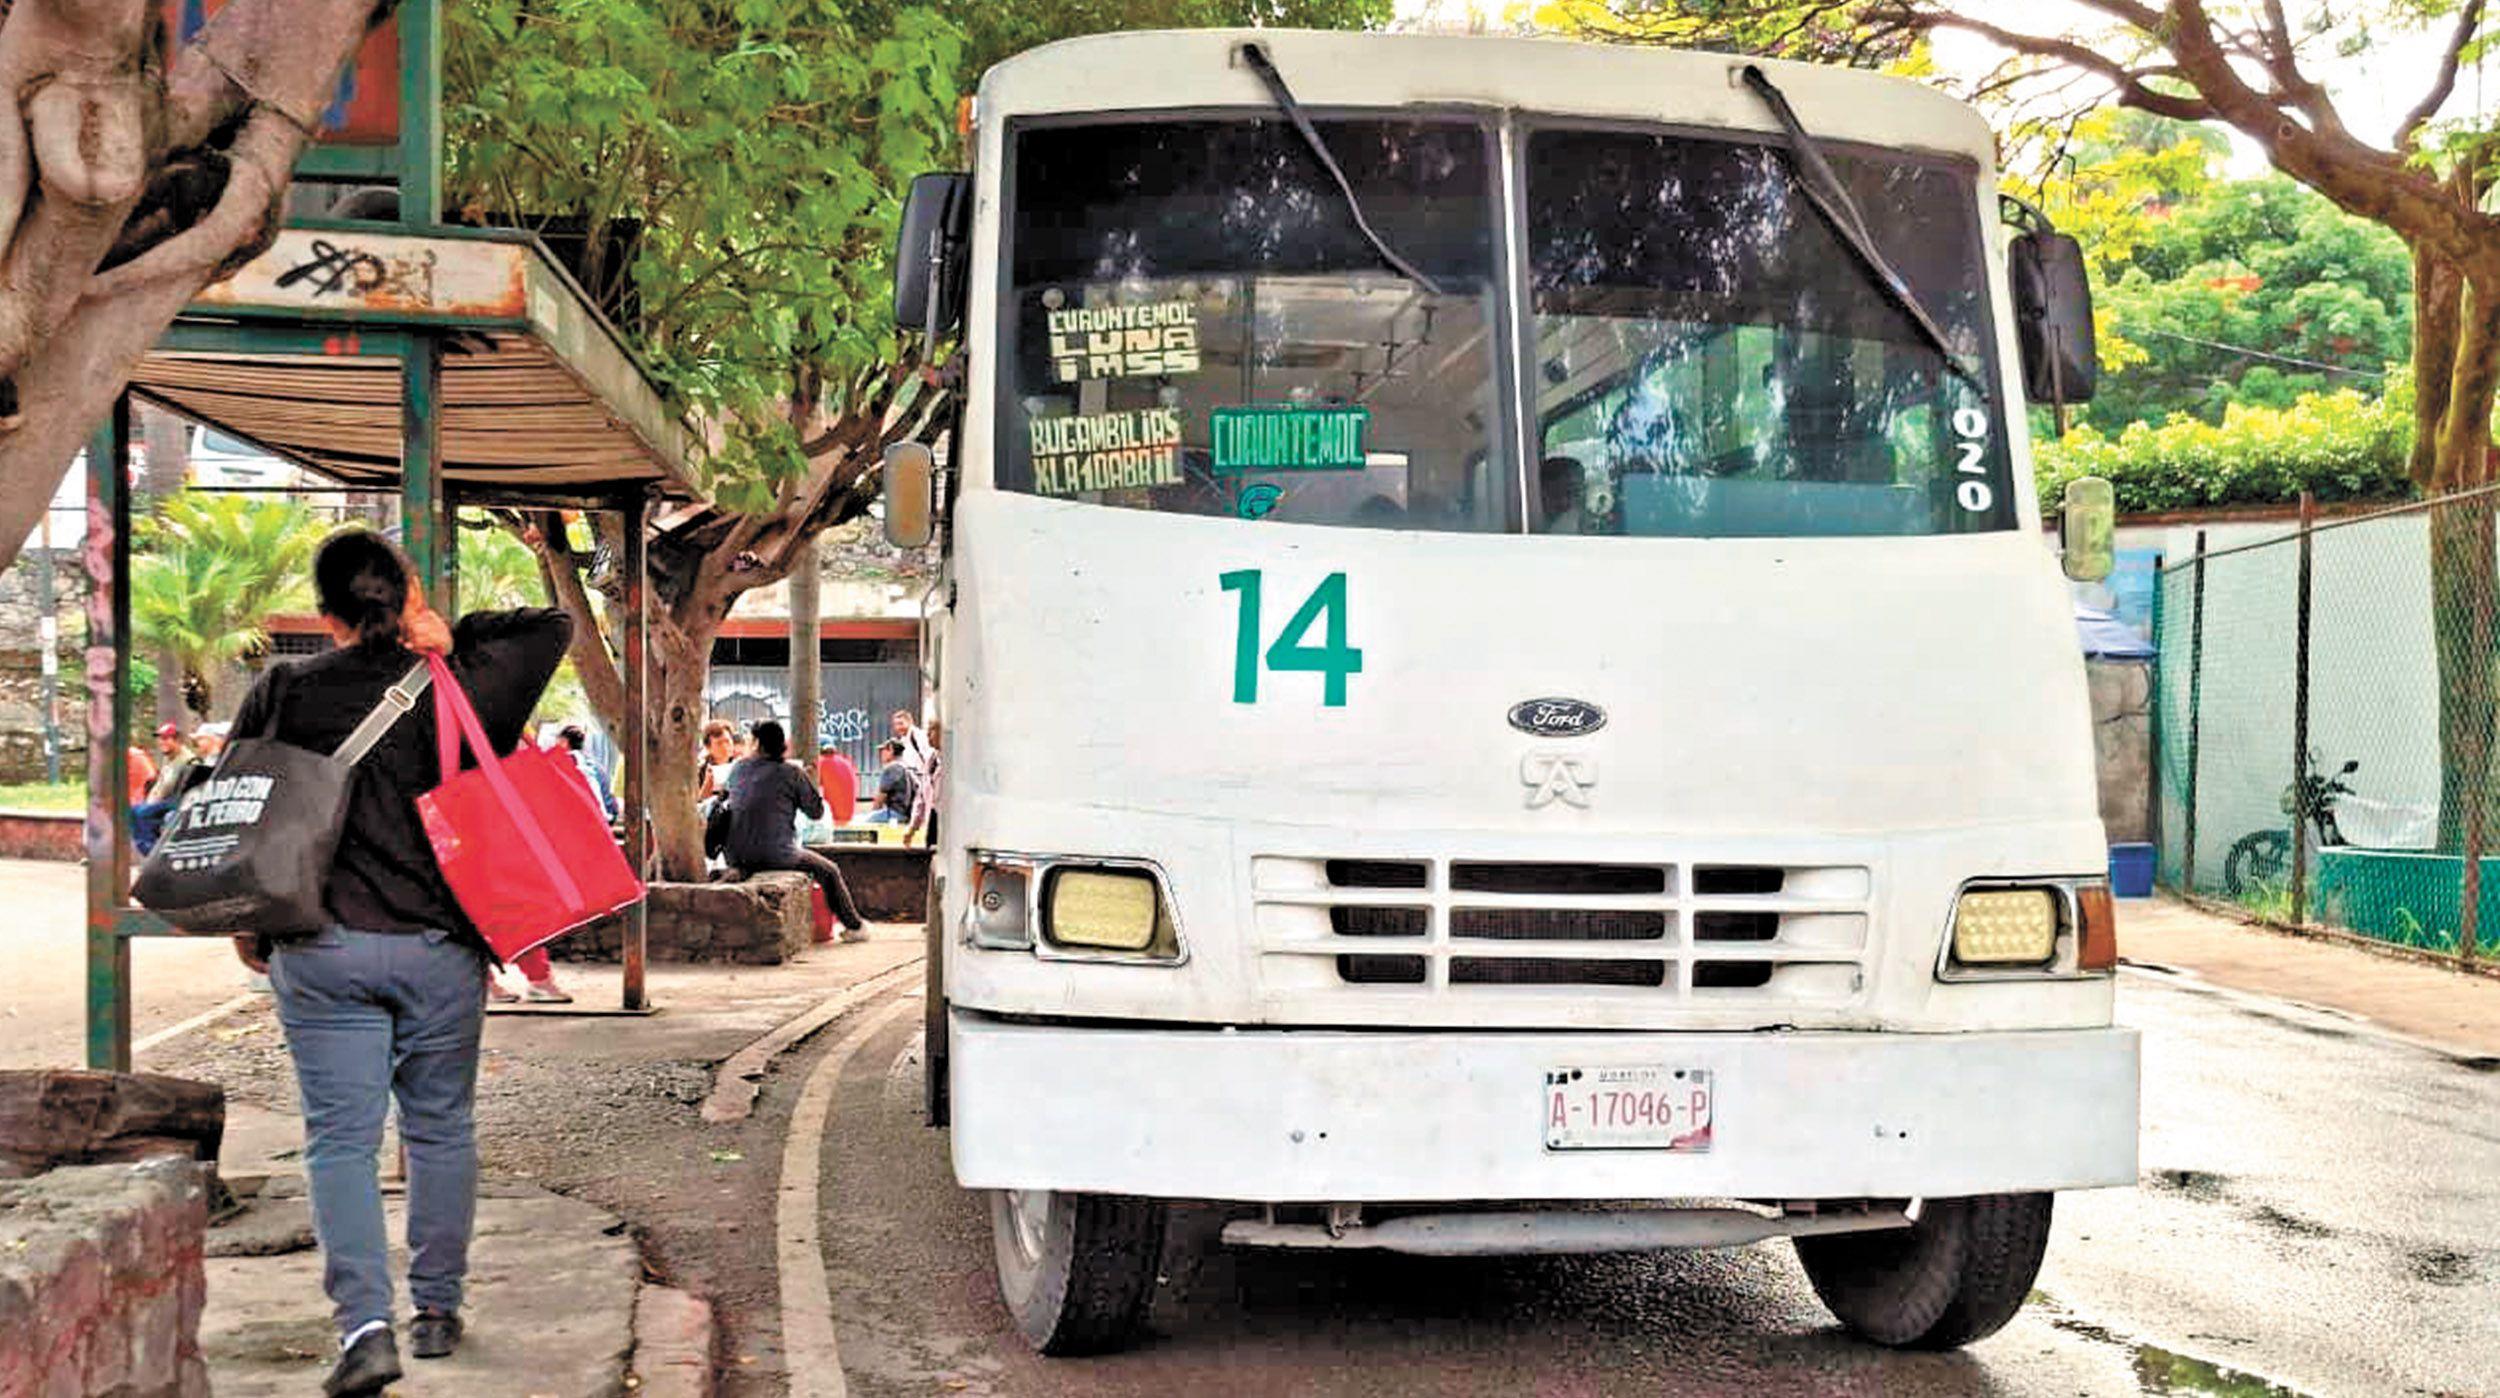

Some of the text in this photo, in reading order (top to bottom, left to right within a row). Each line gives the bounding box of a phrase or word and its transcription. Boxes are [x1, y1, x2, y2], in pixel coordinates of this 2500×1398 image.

[1051, 327, 1196, 357] LUNA
[1952, 408, 1992, 512] 020
[1219, 569, 1362, 706] 14
[1532, 702, 1585, 727] Ford
[1551, 1091, 1707, 1128] A-17046-P
